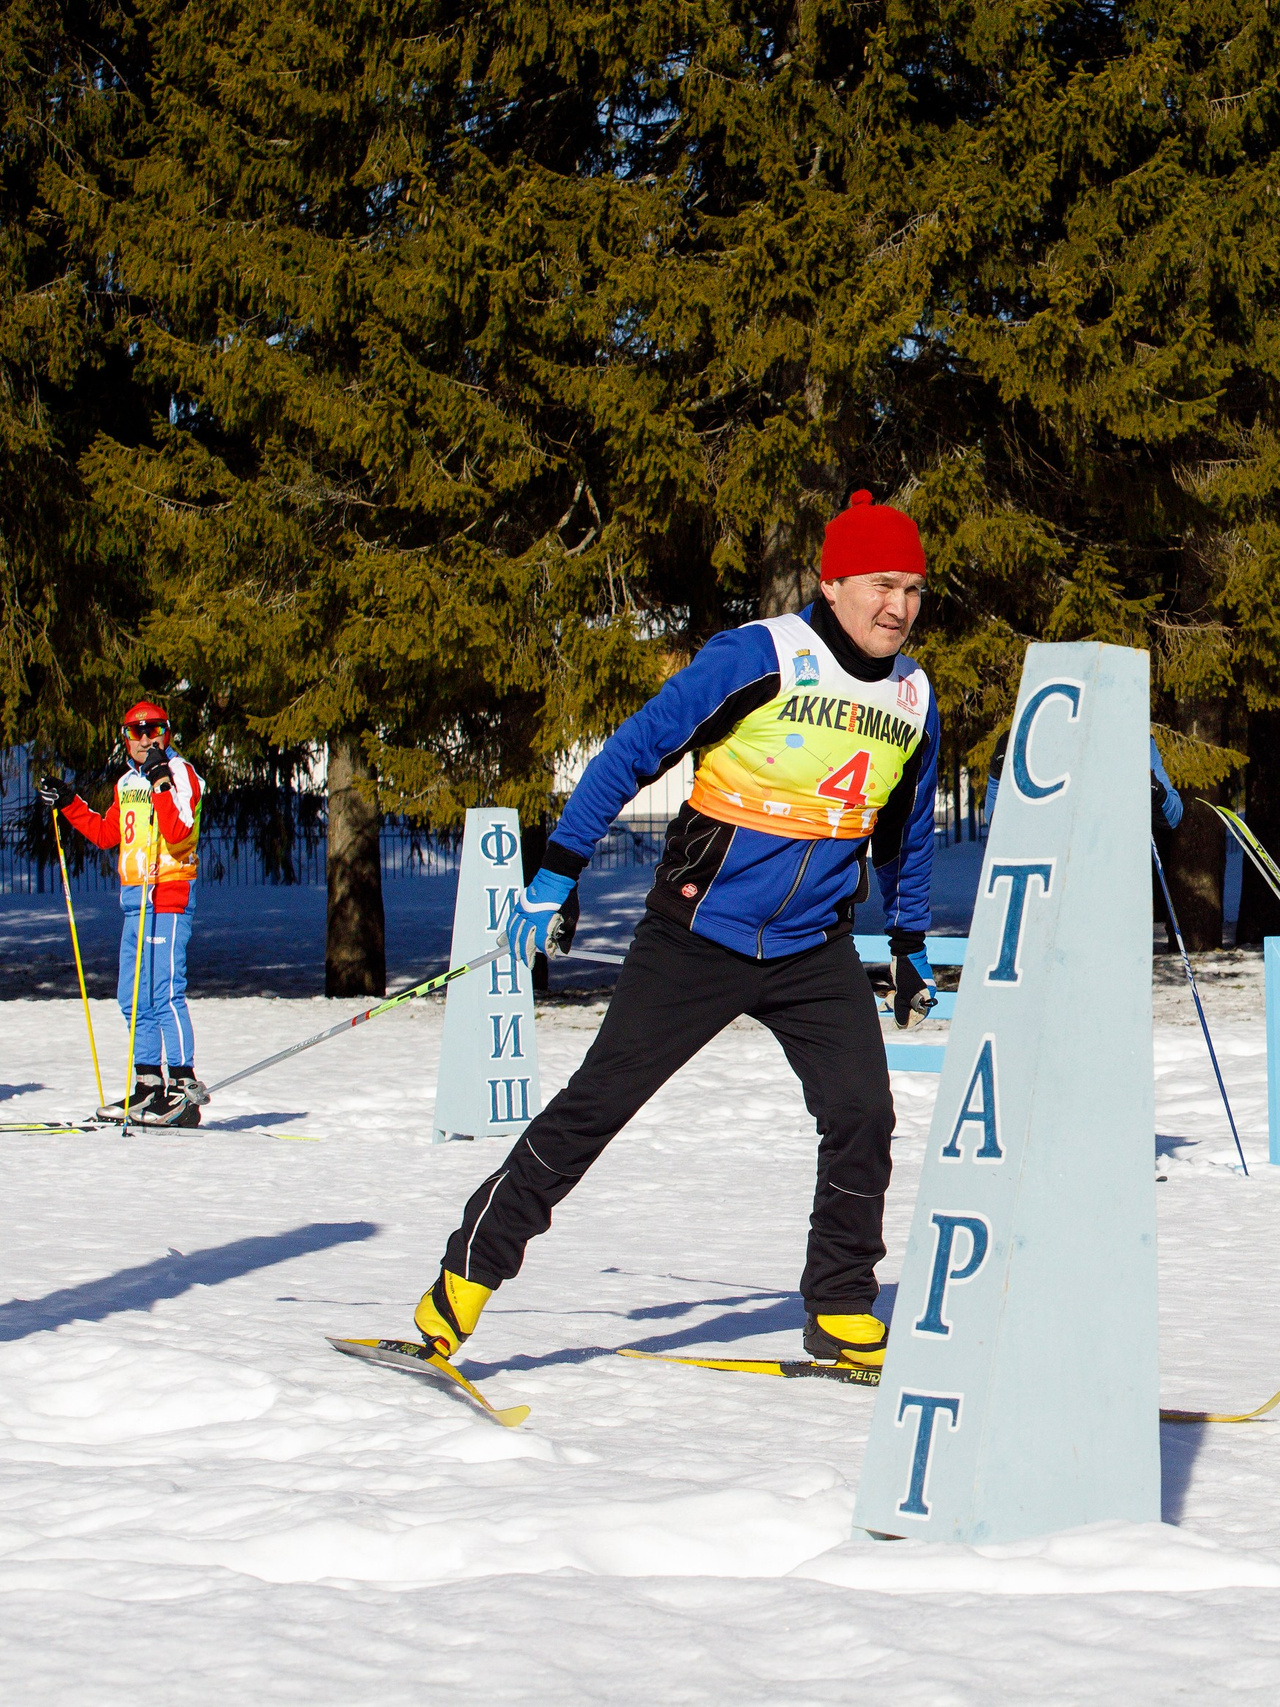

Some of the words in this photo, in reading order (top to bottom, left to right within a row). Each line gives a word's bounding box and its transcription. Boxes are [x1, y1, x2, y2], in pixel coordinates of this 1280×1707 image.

[777, 695, 917, 753] AKKERMANN
[817, 750, 871, 810] 4
[124, 810, 135, 846] 8
[480, 821, 534, 1126] ФИНИШ
[895, 680, 1083, 1519] СТАРТ
